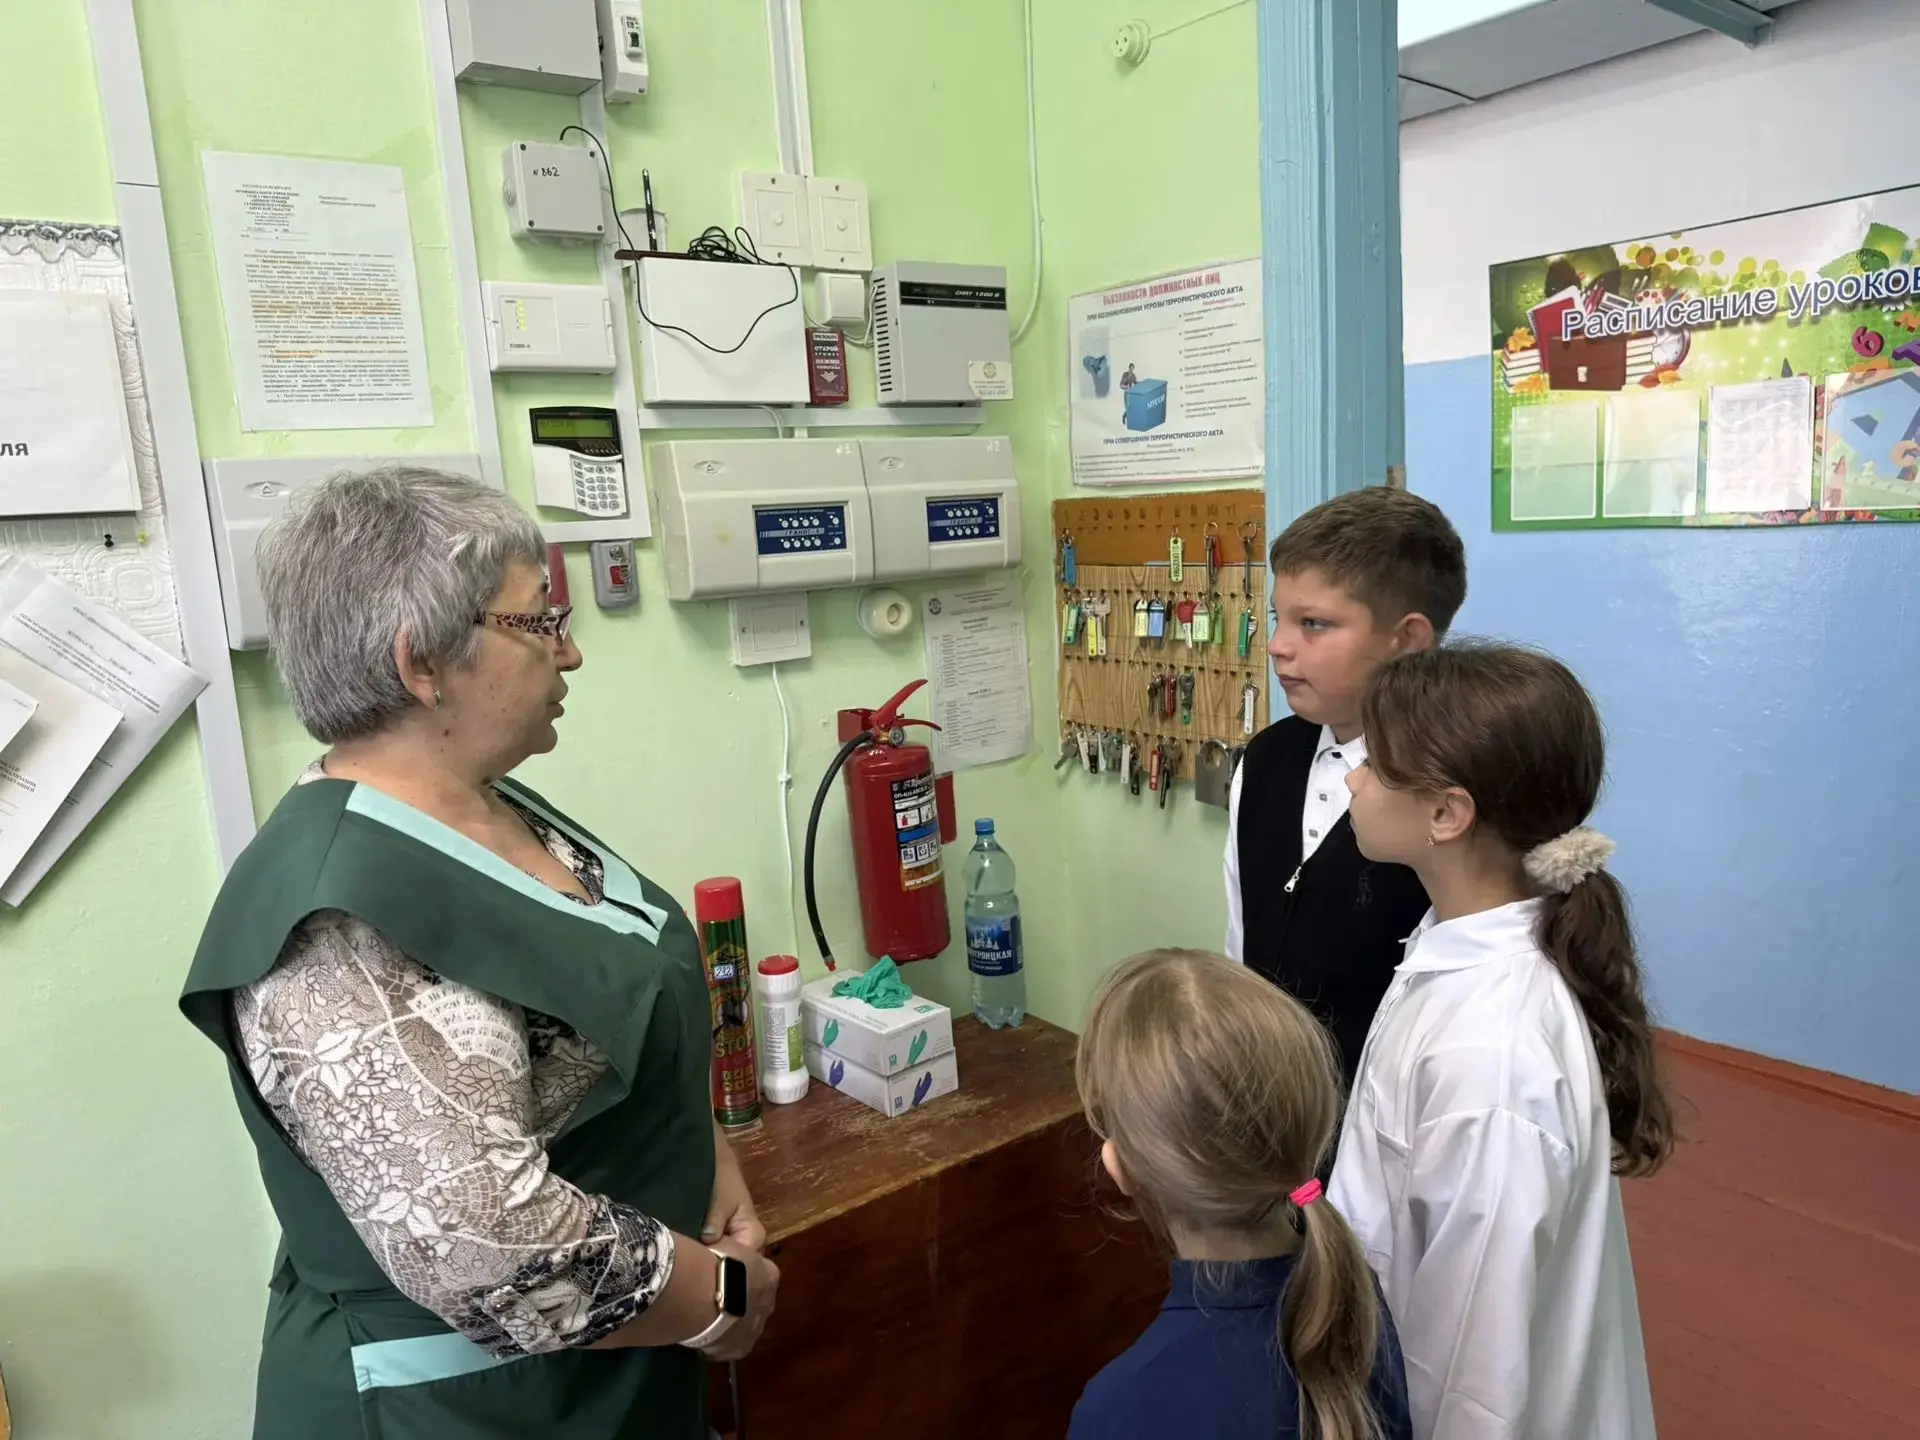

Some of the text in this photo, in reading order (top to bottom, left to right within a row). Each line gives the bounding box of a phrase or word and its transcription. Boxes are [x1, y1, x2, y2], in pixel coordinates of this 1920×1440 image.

[1165, 288, 1225, 306] ТЕРРОРИСТИЧЕСКОГО
[1227, 285, 1243, 295] АКТА
[1563, 286, 1777, 340] Расписание
[1150, 430, 1208, 441] ТЕРРОРИСТИЧЕСКОГО
[1208, 428, 1224, 437] АКТА
